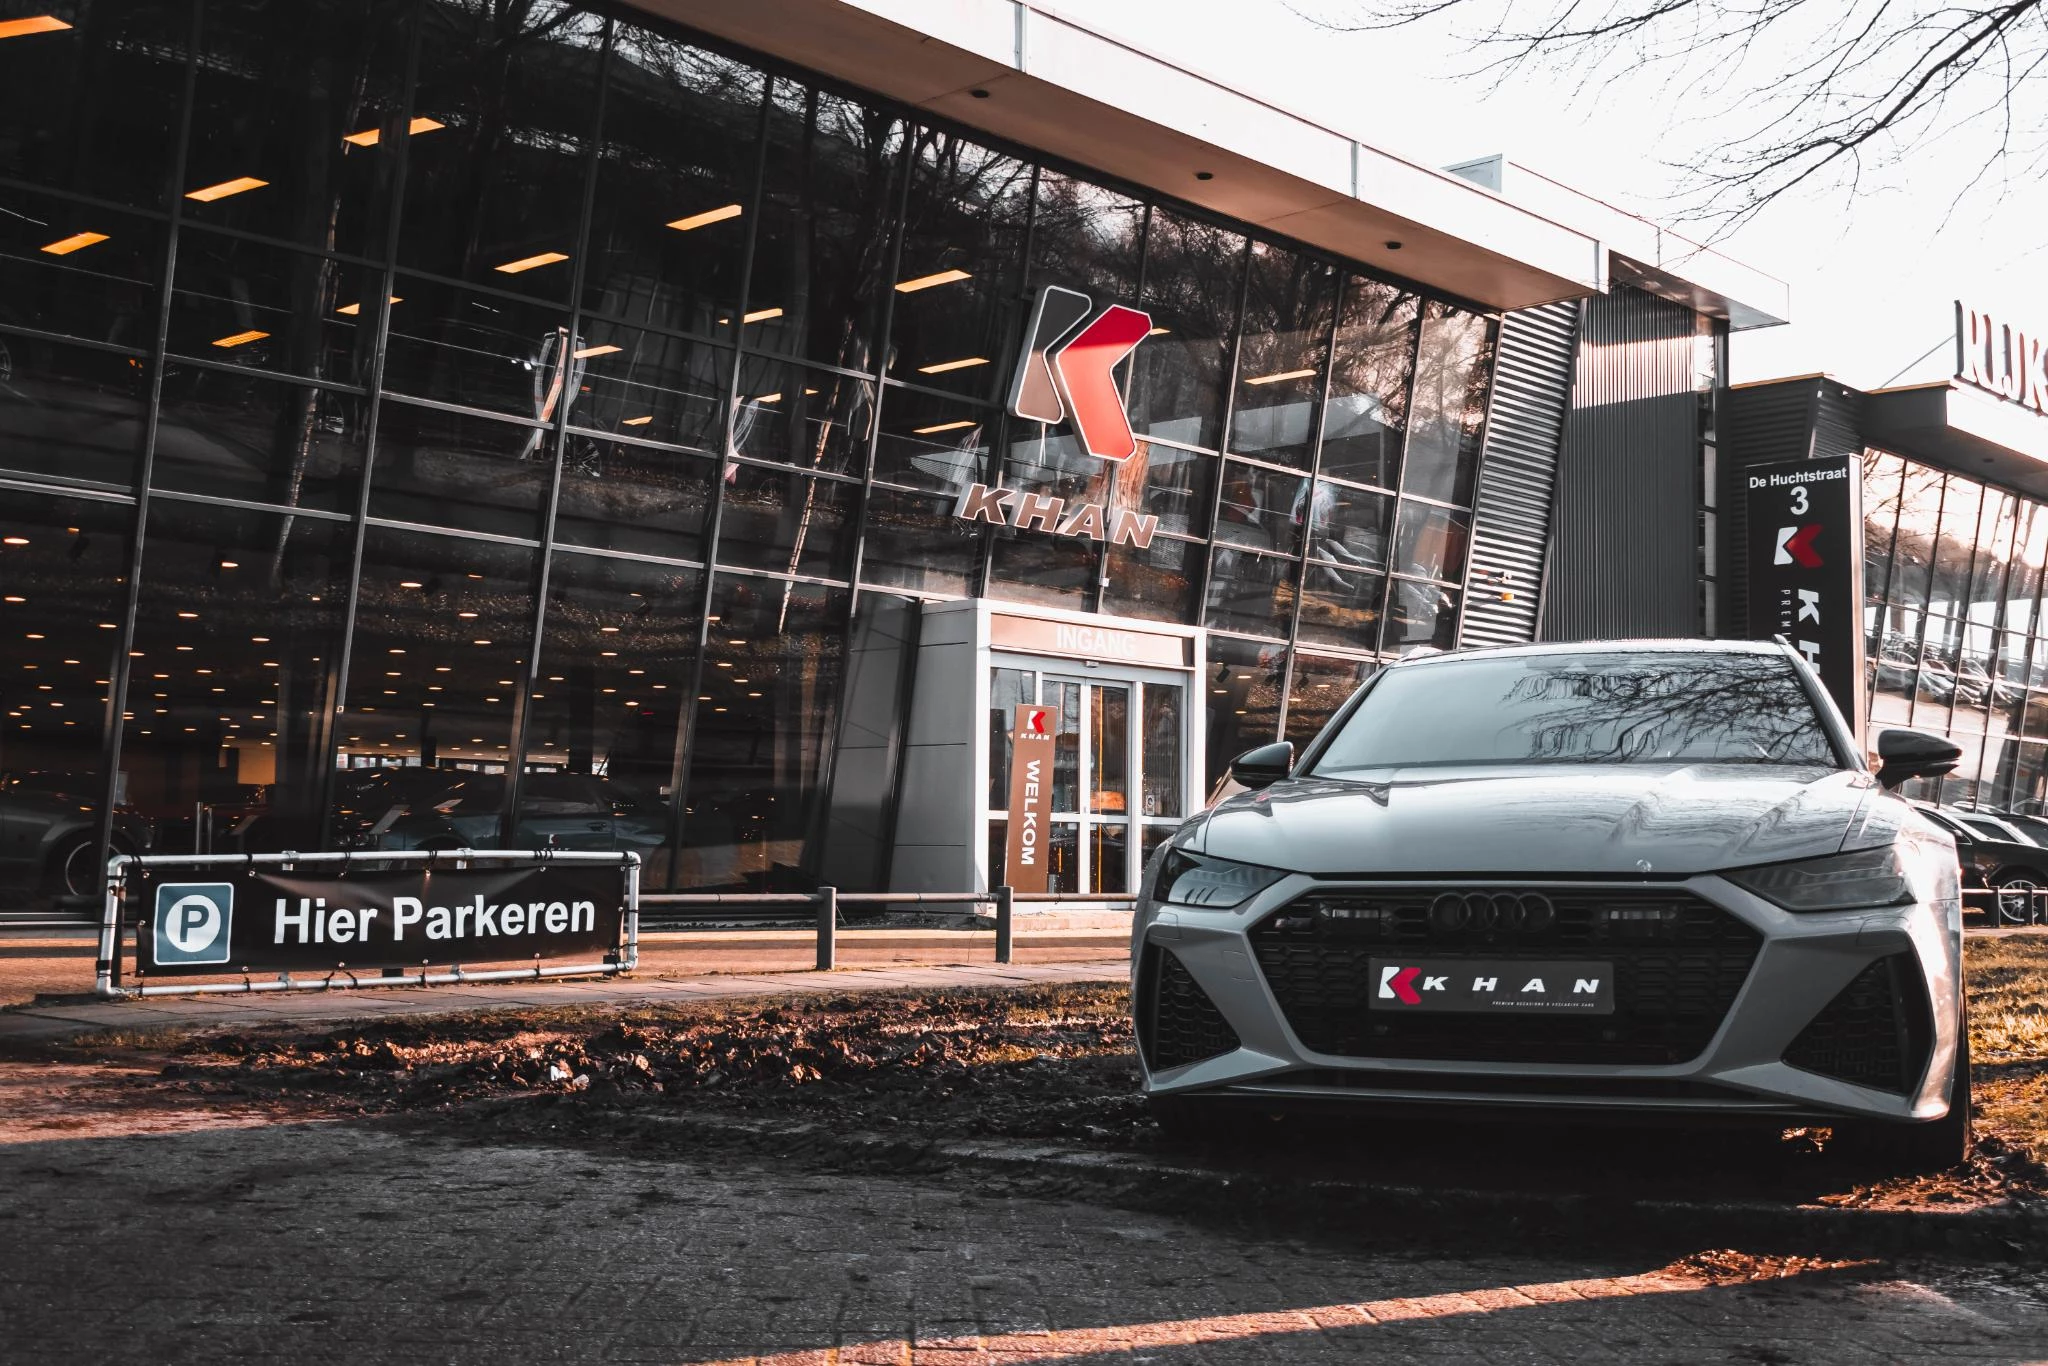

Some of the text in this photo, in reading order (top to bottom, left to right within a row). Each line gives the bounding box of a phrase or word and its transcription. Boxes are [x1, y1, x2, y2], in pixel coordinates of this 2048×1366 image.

[1954, 299, 2048, 414] RIJK
[1749, 466, 1847, 489] De Huchtstraat
[1790, 485, 1809, 515] 3
[956, 482, 1158, 549] KHAN
[1056, 623, 1136, 657] INGANG
[1780, 589, 1792, 644] PREMI
[1020, 759, 1041, 865] WELKOM
[274, 894, 595, 944] Hier Parkeren
